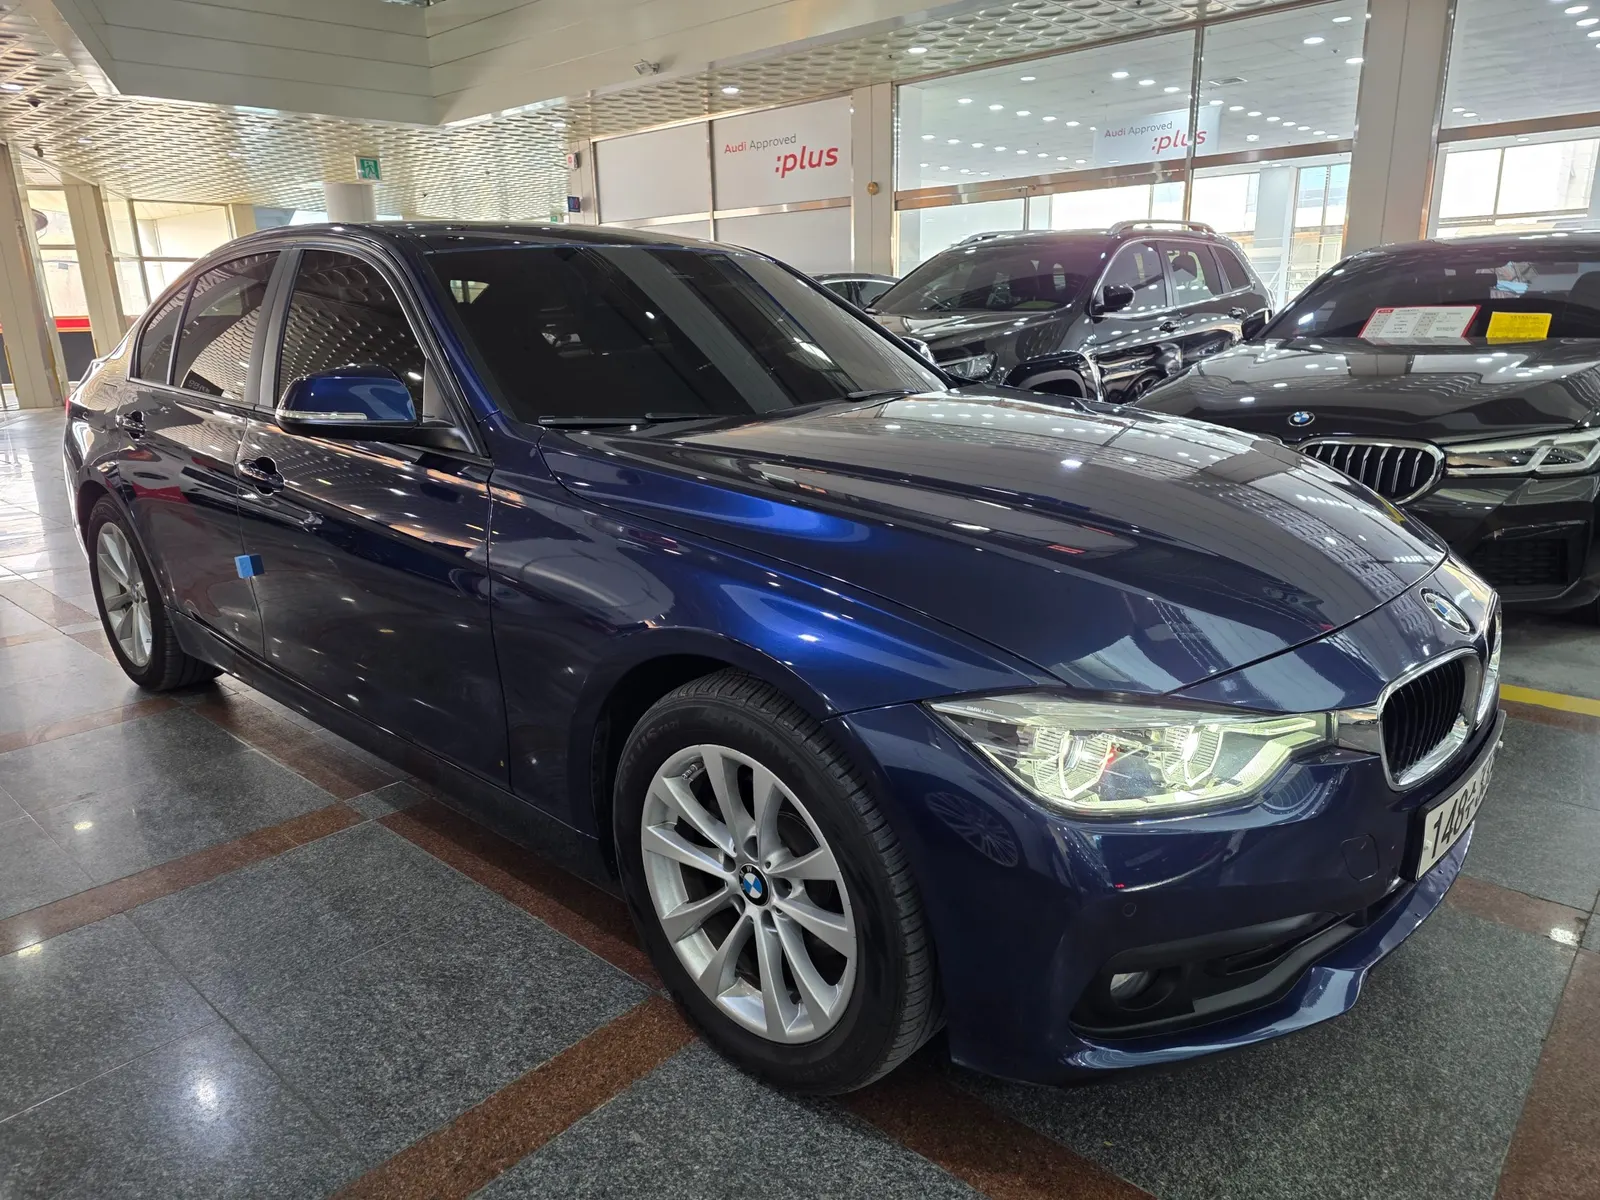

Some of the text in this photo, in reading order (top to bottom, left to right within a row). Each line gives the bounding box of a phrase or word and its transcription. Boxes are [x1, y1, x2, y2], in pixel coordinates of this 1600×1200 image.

[1104, 120, 1173, 139] Audi Approved
[724, 133, 797, 154] Audi Approved
[774, 145, 839, 179] :plus
